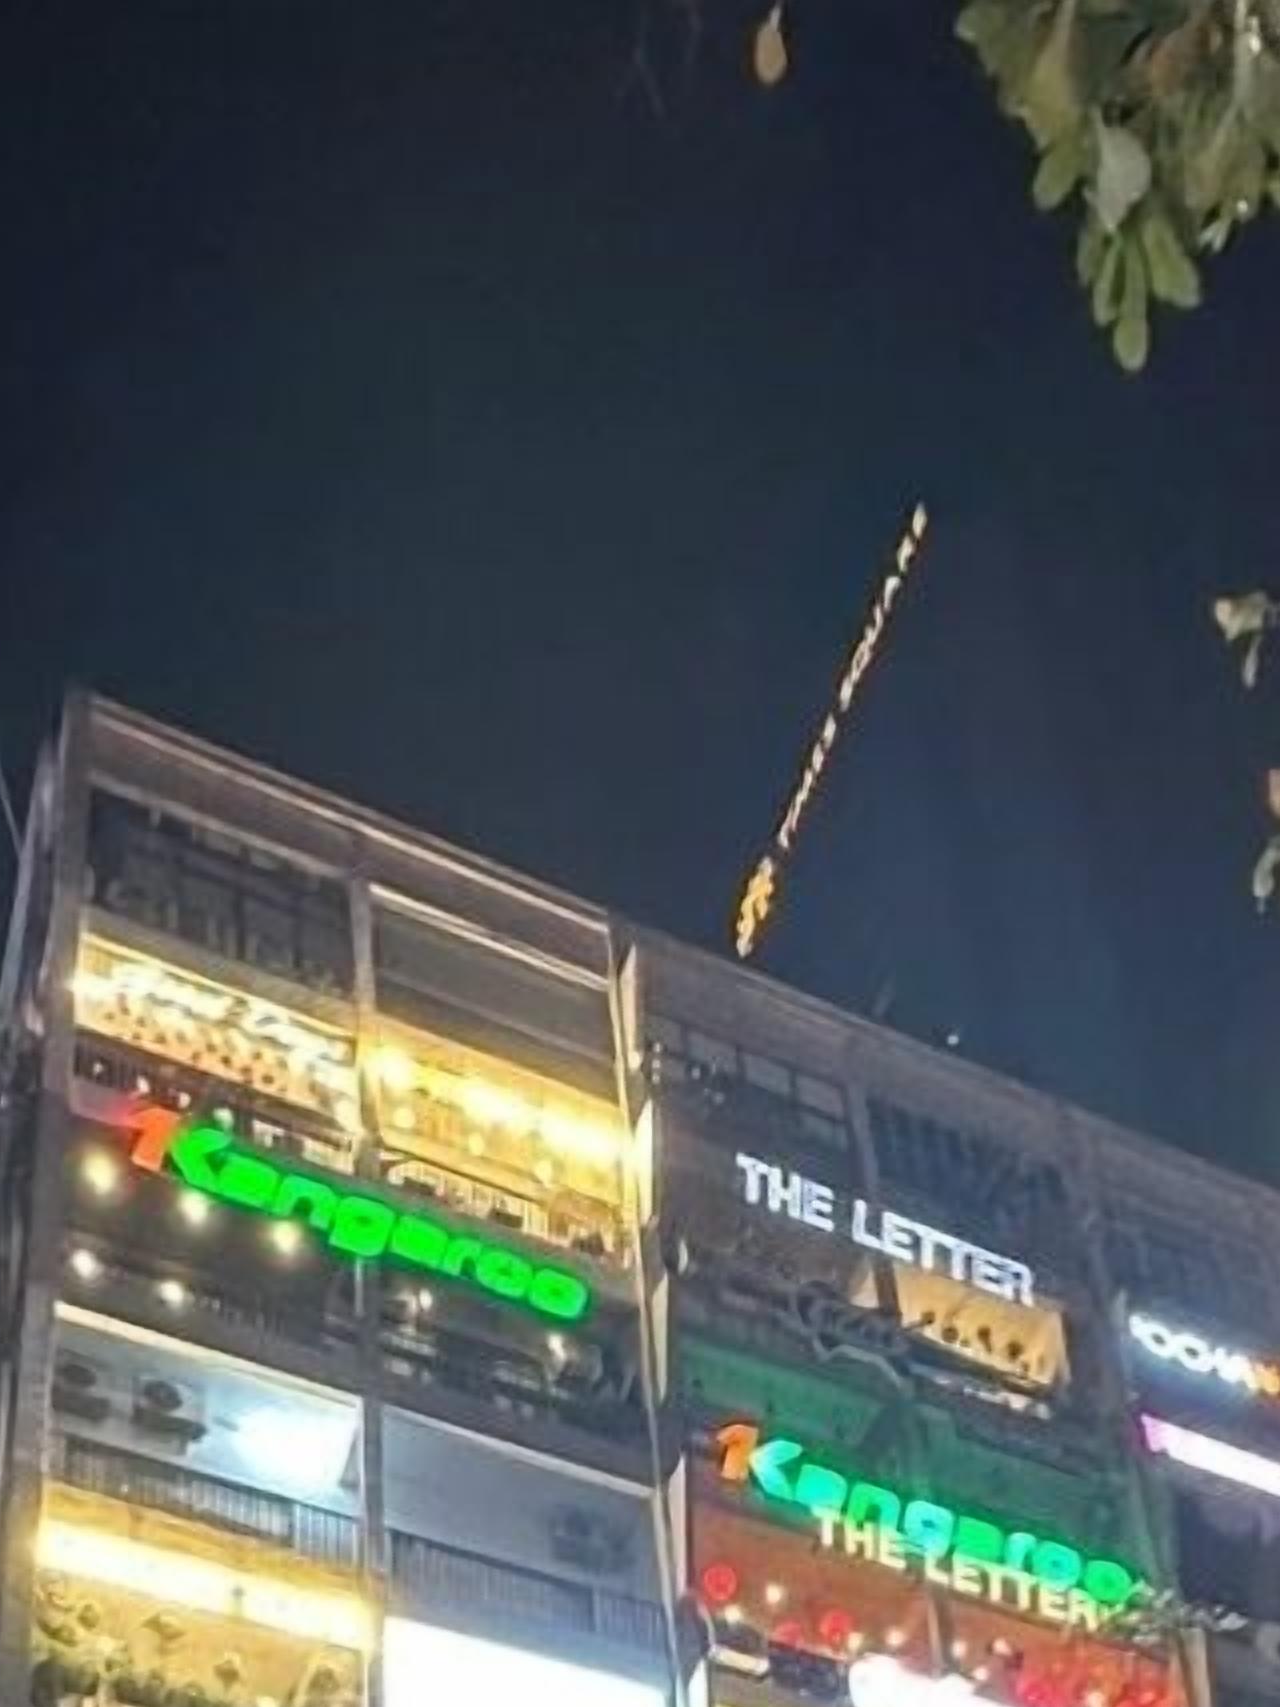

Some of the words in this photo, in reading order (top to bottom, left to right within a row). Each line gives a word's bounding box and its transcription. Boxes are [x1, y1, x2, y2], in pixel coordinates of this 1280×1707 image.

[735, 1152, 835, 1233] THE
[851, 1198, 1035, 1308] LETTER
[809, 1503, 908, 1570] THE
[925, 1552, 1100, 1633] LETTER
